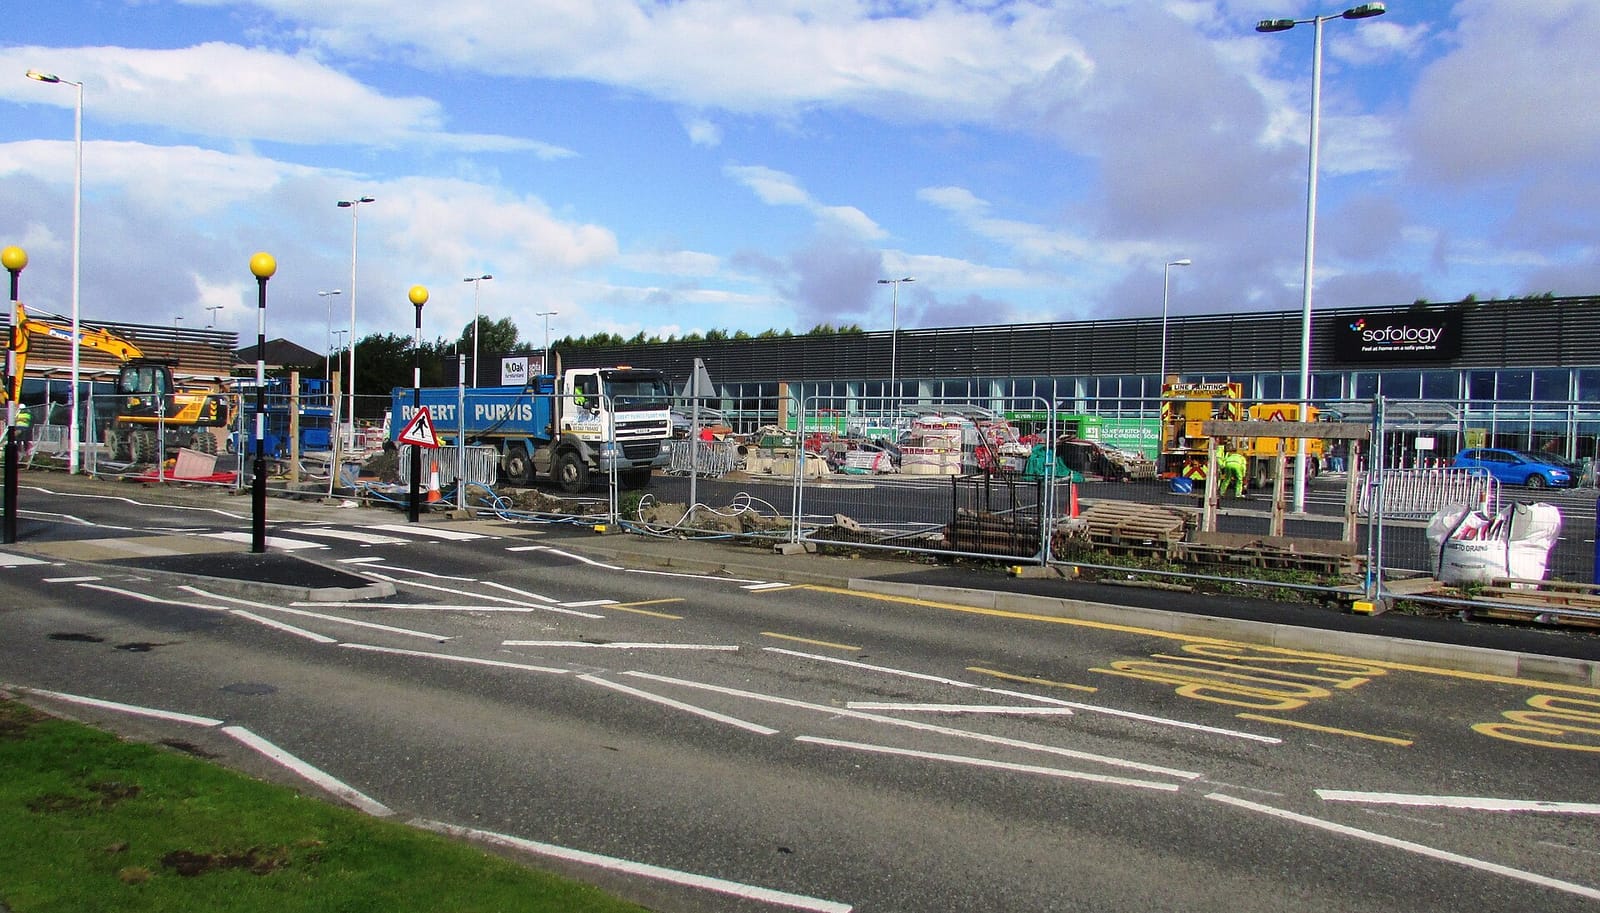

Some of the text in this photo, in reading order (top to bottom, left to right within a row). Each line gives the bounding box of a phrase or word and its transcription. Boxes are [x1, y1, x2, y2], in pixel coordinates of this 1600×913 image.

[1362, 325, 1442, 344] sofology
[511, 362, 525, 373] Oak
[475, 404, 533, 421] PURVIS
